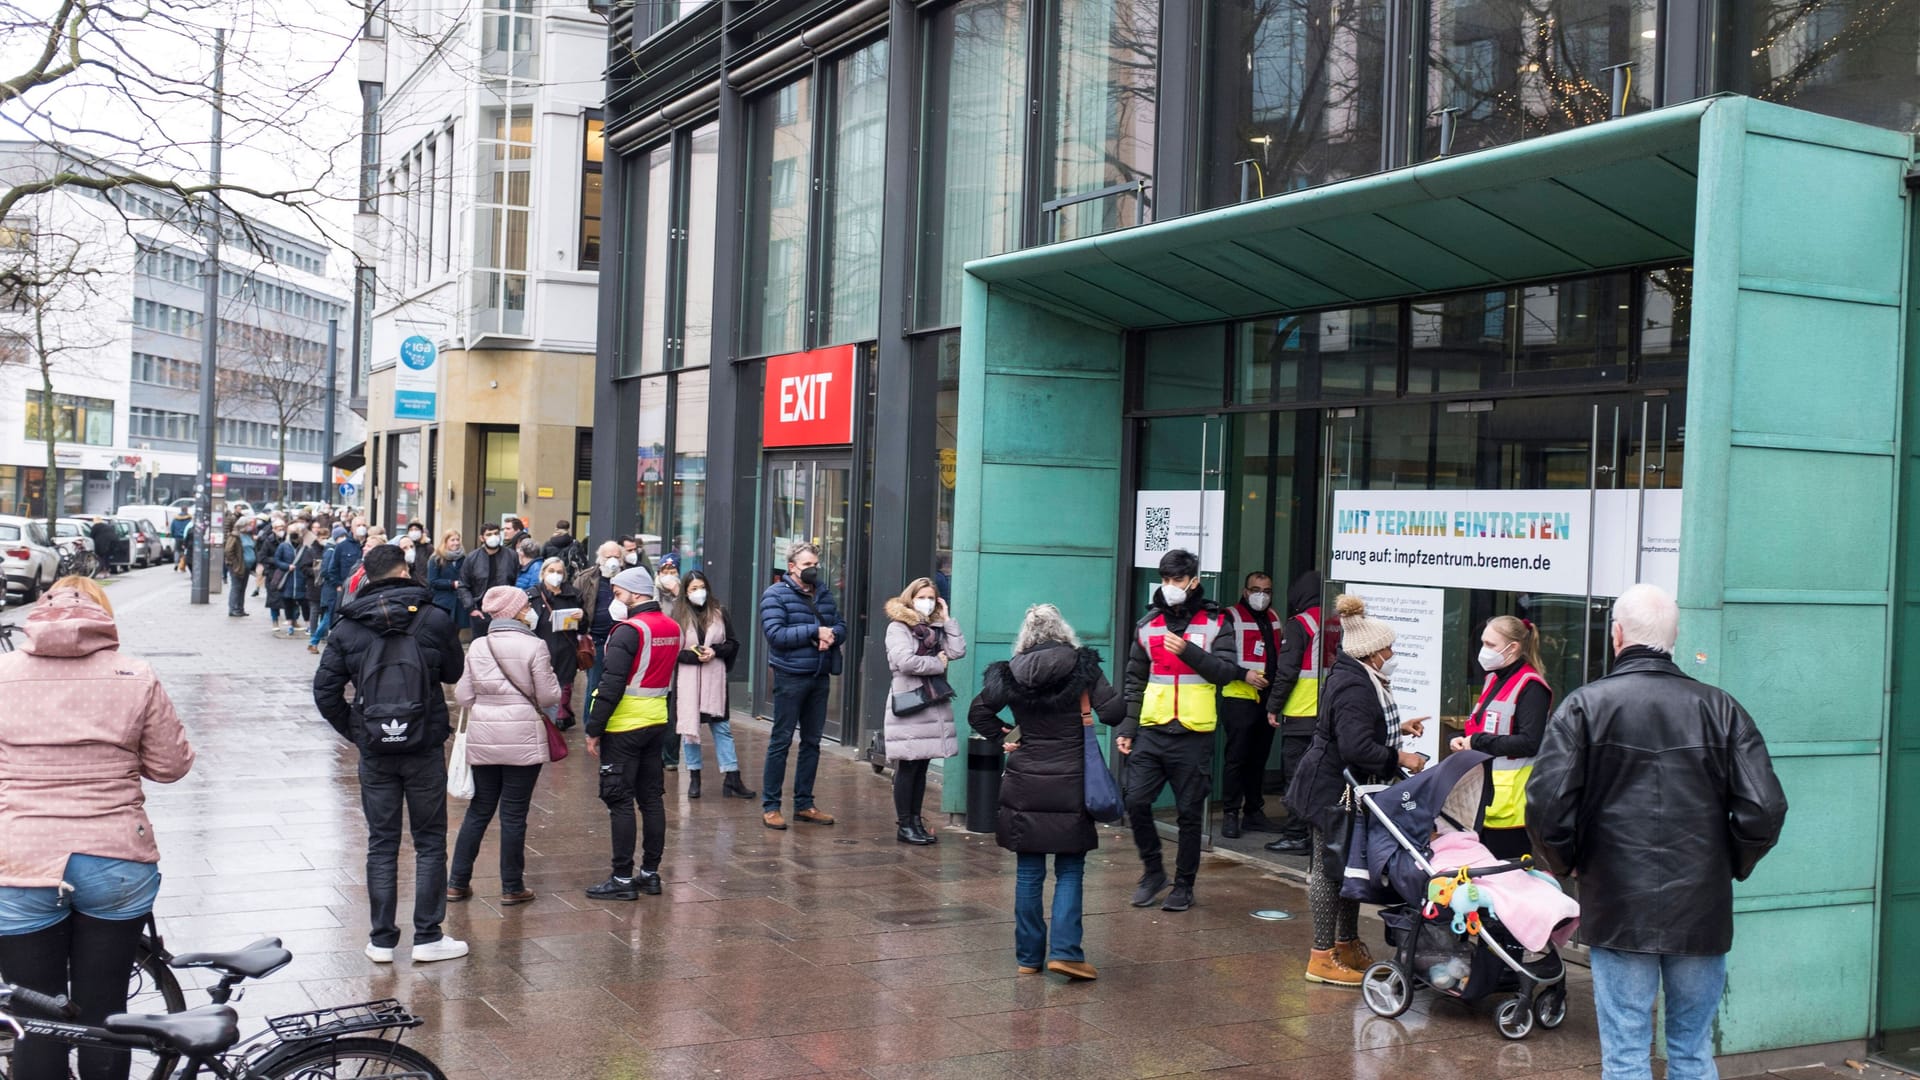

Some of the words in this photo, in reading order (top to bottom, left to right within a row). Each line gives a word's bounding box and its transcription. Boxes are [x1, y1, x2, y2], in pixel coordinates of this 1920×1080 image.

[780, 372, 833, 422] EXIT
[1338, 510, 1370, 534] MIT
[1375, 510, 1447, 537] TERMIN
[1454, 511, 1570, 540] EINTRETEN
[1369, 548, 1392, 563] auf:
[1394, 548, 1551, 571] impfzentrum.bremen.de
